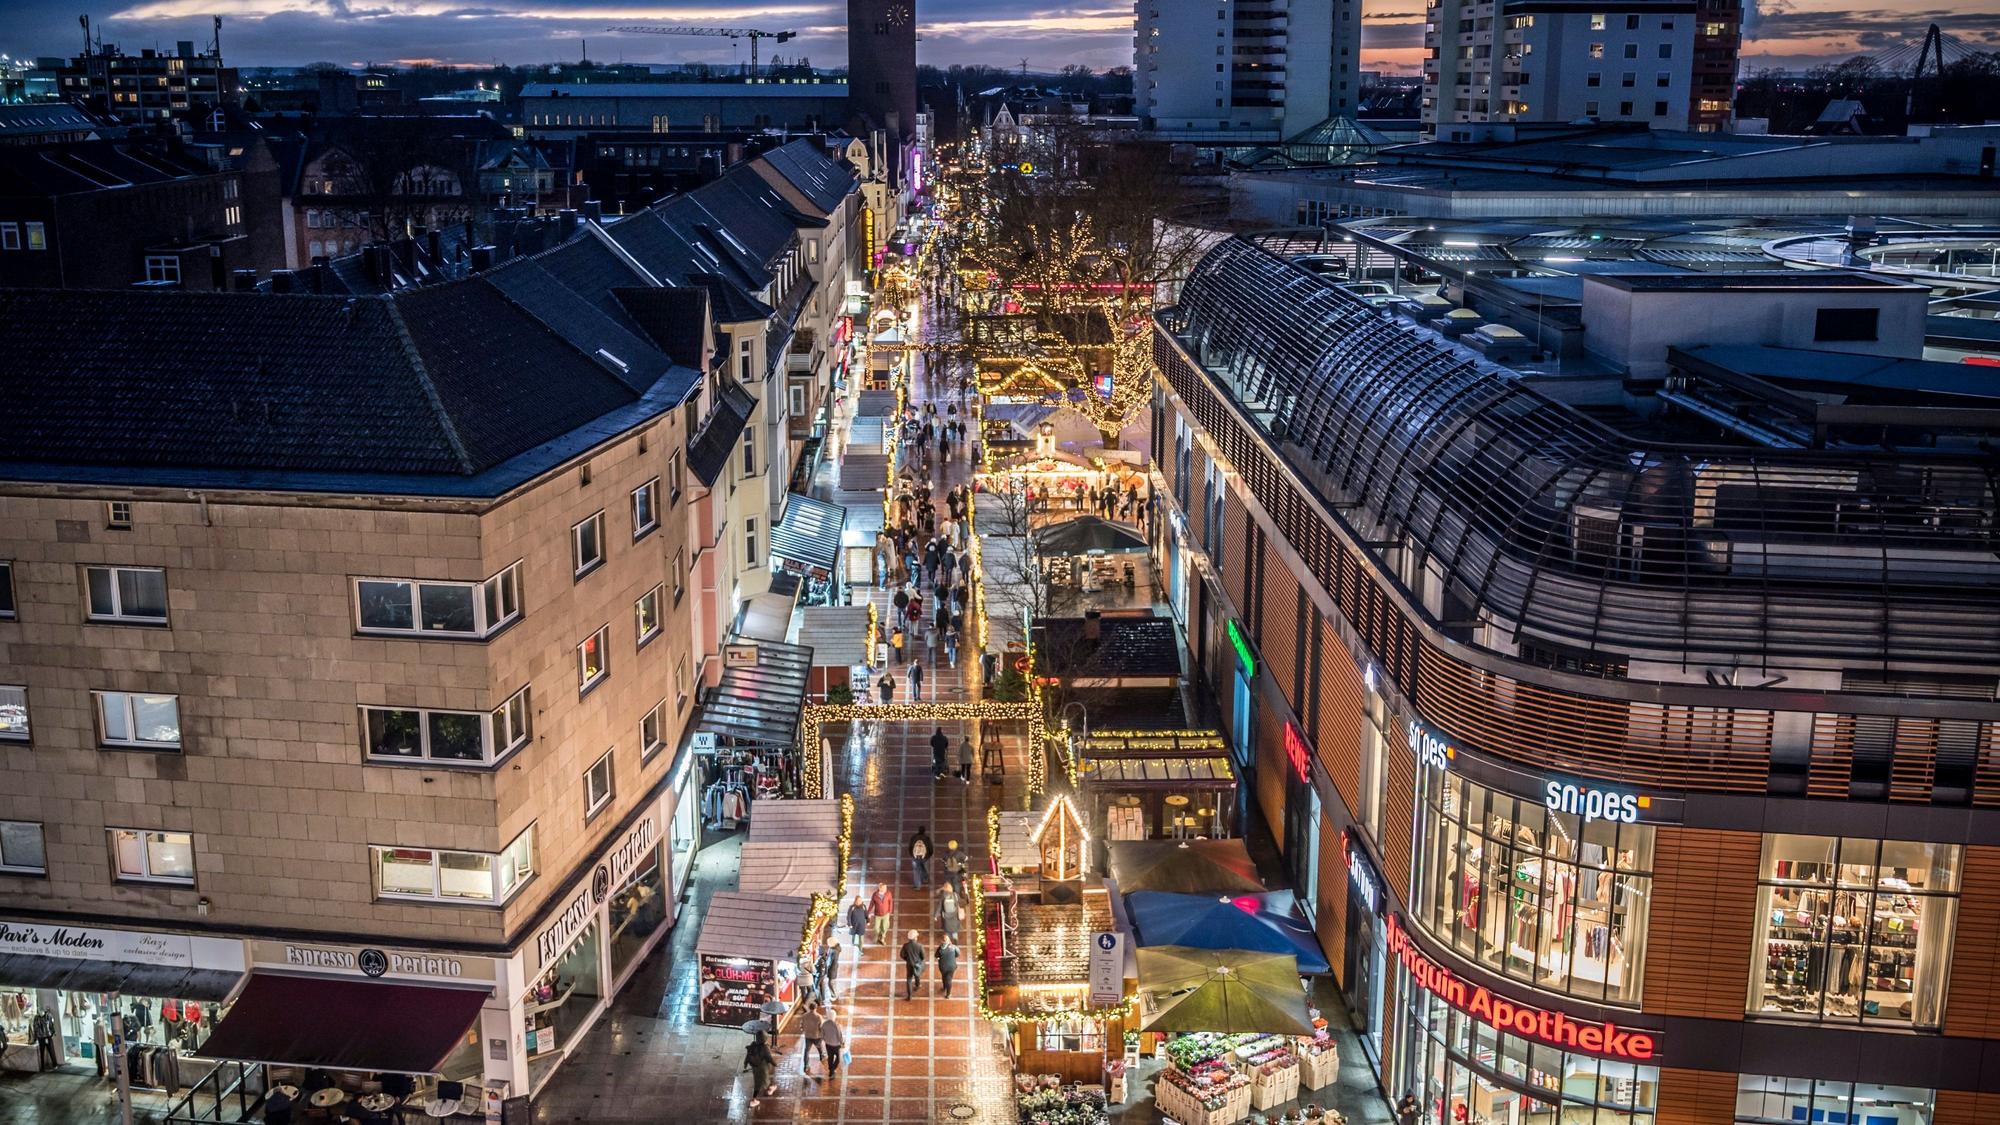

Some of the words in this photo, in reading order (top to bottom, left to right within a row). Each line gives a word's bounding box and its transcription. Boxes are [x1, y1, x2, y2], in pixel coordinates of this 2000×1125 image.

[1408, 720, 1447, 770] snipes
[1546, 781, 1637, 823] snipes
[611, 818, 655, 885] Perfetto
[43, 928, 104, 949] Moden
[537, 889, 592, 969] Espresso
[52, 949, 62, 958] up
[63, 949, 71, 957] to
[158, 949, 185, 960] design
[286, 946, 355, 969] Espresso
[391, 954, 462, 977] Perfetto
[715, 966, 761, 982] GLÜH-MET
[1395, 924, 1467, 1008] Pinguin
[1469, 986, 1654, 1059] Apotheke
